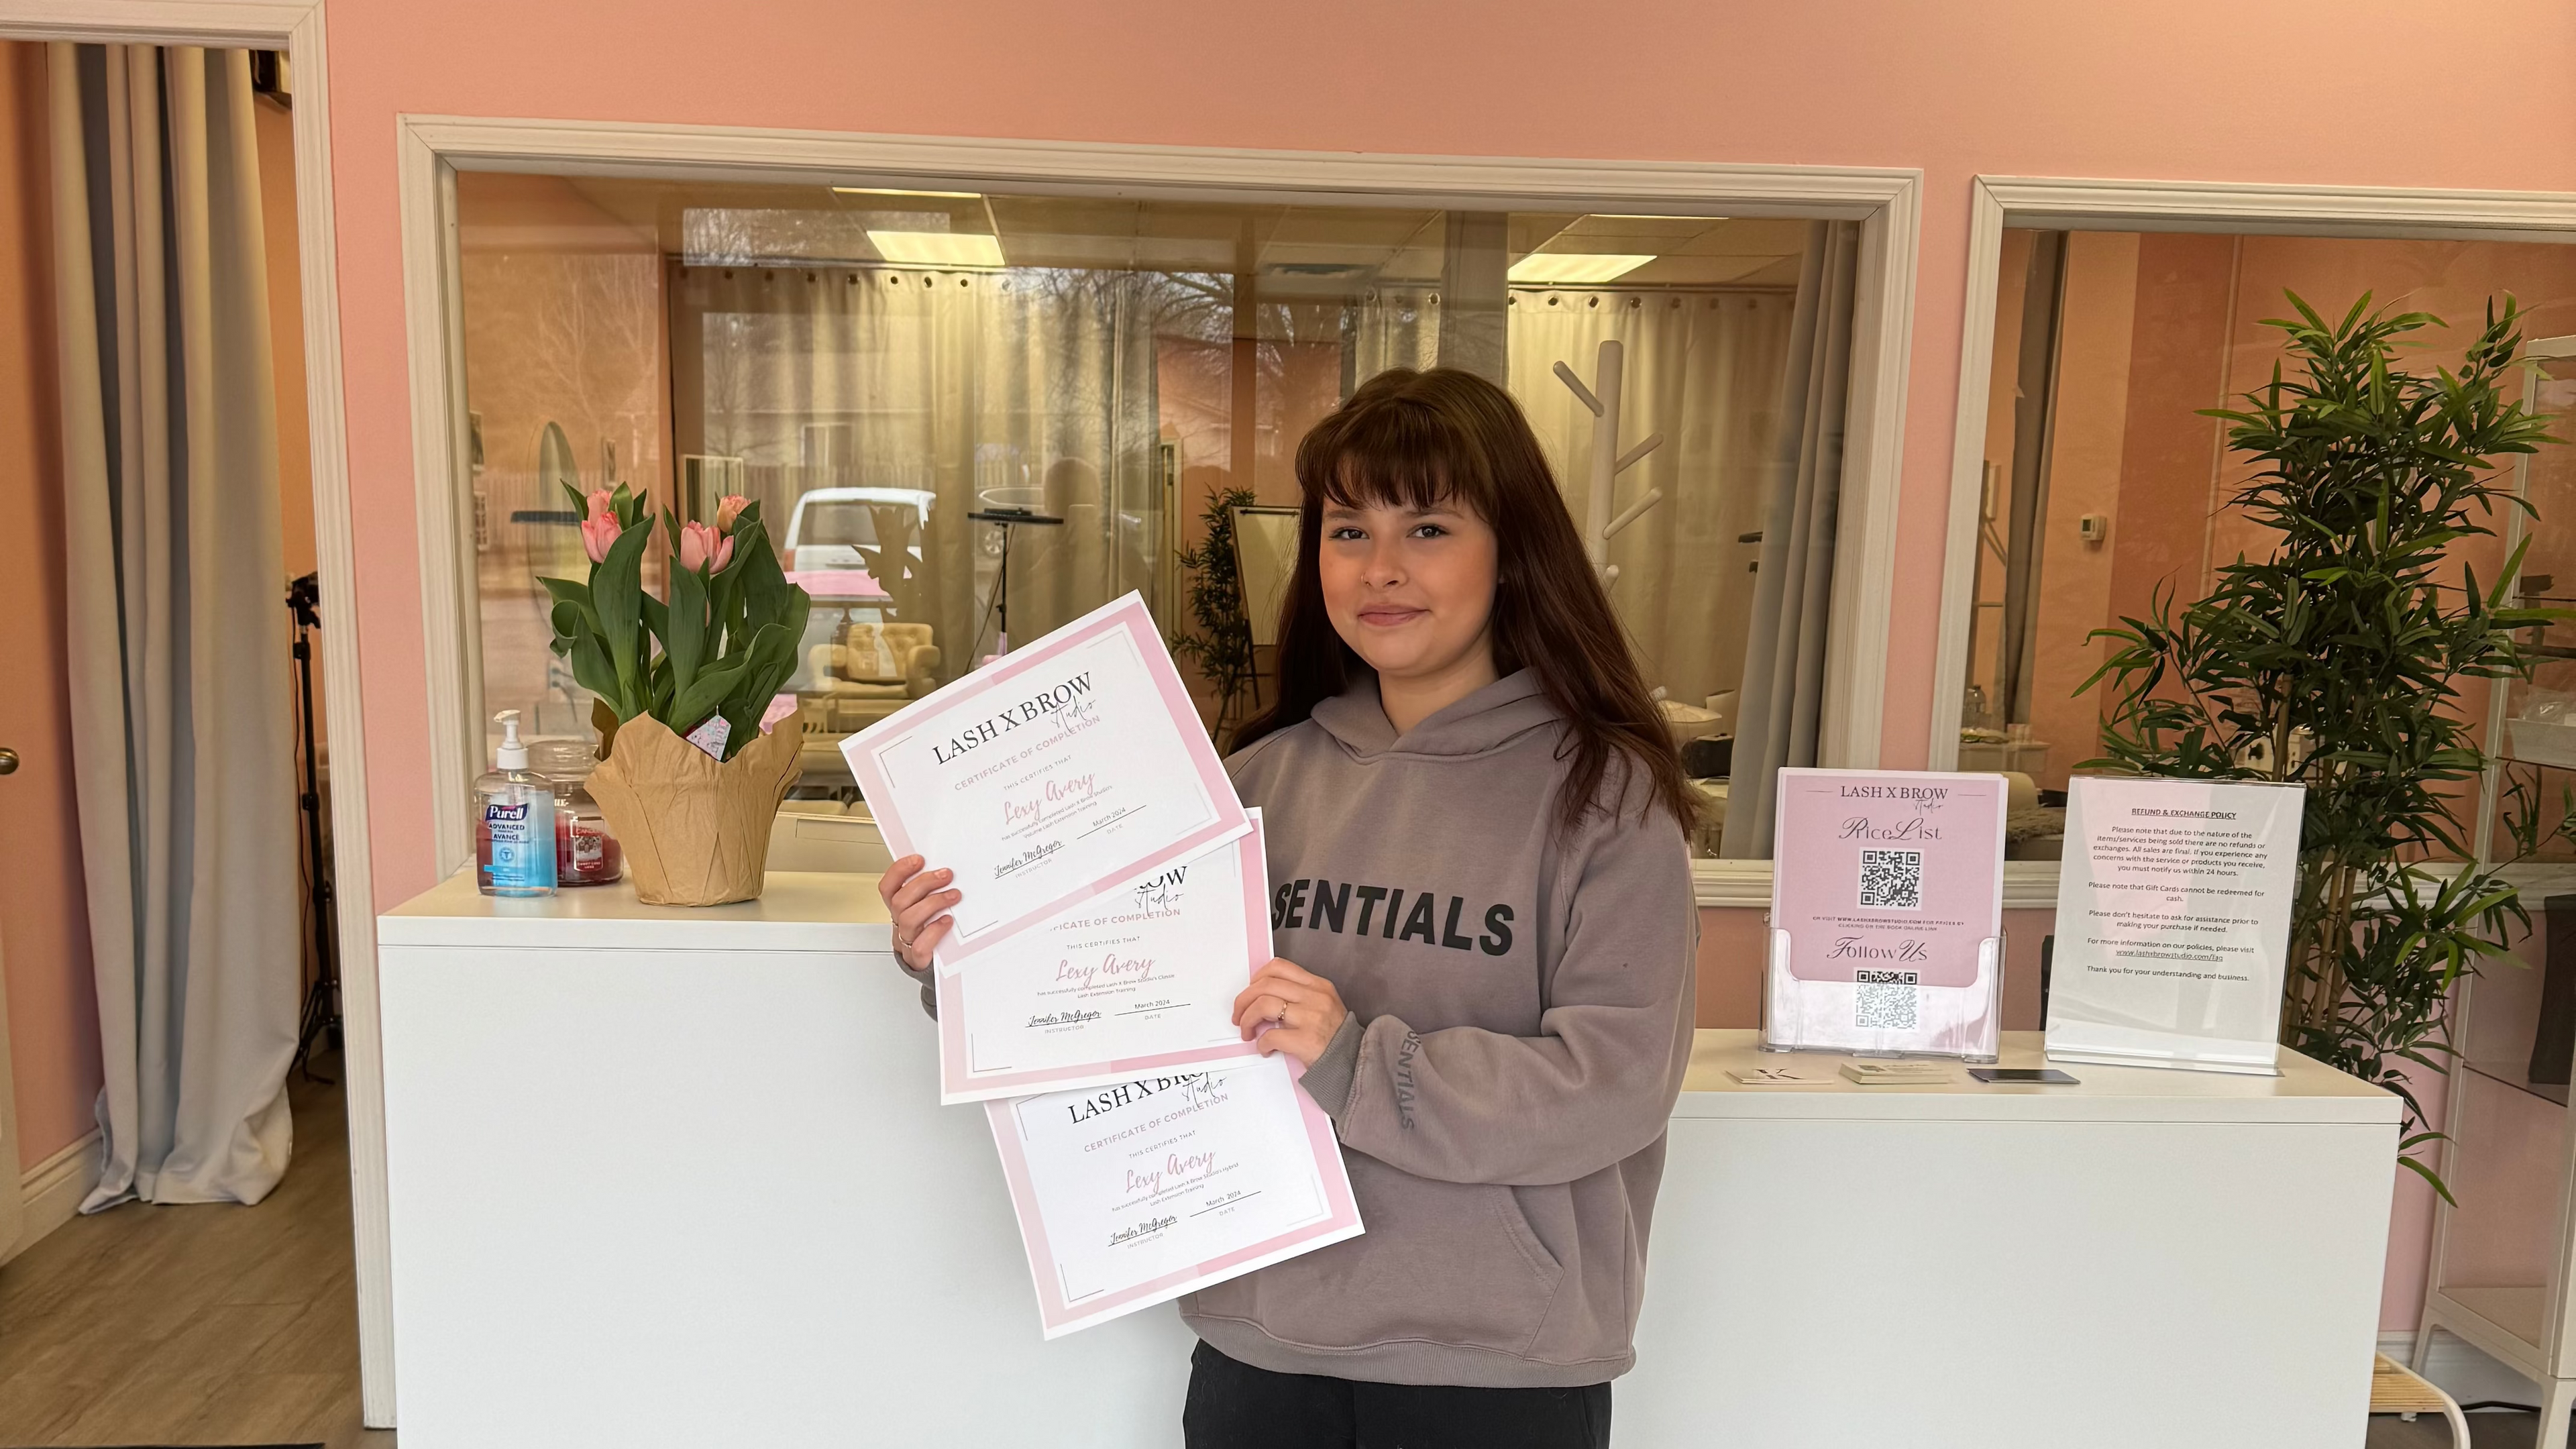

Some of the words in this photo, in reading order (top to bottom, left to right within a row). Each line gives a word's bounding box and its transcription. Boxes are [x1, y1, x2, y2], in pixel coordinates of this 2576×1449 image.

[932, 719, 999, 765] LASH
[998, 709, 1021, 732] X
[1019, 672, 1091, 722] BROW
[955, 755, 1018, 791] CERTIFICATE
[1020, 747, 1033, 759] OF
[1036, 715, 1100, 751] COMPLETION
[1004, 782, 1018, 792] THIS
[1020, 764, 1053, 784] CERTIFIES
[1055, 755, 1071, 767] THAT
[1004, 798, 1042, 824] Lexy
[1046, 773, 1095, 801] Avery
[1841, 786, 1882, 798] LASH
[1886, 787, 1898, 798] X
[1900, 787, 1948, 800] BROW
[490, 806, 523, 819] Purell
[1093, 813, 1110, 827] March
[1112, 807, 1126, 818] 2024
[2132, 808, 2161, 816] REFUND
[2171, 809, 2210, 818] EXCHANGE
[2211, 812, 2237, 820] POLICY
[1107, 824, 1123, 835] DATE
[1839, 816, 1892, 839] Price
[1890, 818, 1942, 841] List
[2093, 845, 2131, 853] exchanges.
[1094, 918, 1108, 926] OF
[1111, 908, 1181, 924] COMPLETION
[1272, 879, 1514, 956] SENTIALS
[1085, 938, 1120, 948] CERTIFIES
[1827, 935, 1896, 959] Follow
[1898, 939, 1927, 962] Us
[2121, 939, 2160, 948] information
[1056, 959, 1097, 986] Lexy
[1102, 953, 1155, 979] Avery
[2152, 970, 2202, 979] understanding
[2218, 973, 2249, 981] business.
[1044, 1024, 1085, 1034] INSTRUCTOR
[1397, 1030, 1421, 1131] SENTIALS
[1068, 1085, 1133, 1124] LASH
[1134, 1080, 1153, 1099] X
[1084, 1124, 1146, 1152] CERTIFICATE
[1148, 1118, 1162, 1128] OF
[1164, 1093, 1228, 1122] COMPLETION
[1130, 1150, 1144, 1159] THIS
[1145, 1138, 1178, 1154] CERTIFIES
[1179, 1130, 1195, 1140] THAT
[1126, 1169, 1163, 1195] Lexy
[1167, 1151, 1216, 1175] Avery
[1205, 1197, 1224, 1207] March
[1227, 1190, 1241, 1199] 2024
[1219, 1207, 1235, 1216] DATE
[1127, 1232, 1163, 1250] INSTRUCTOR
